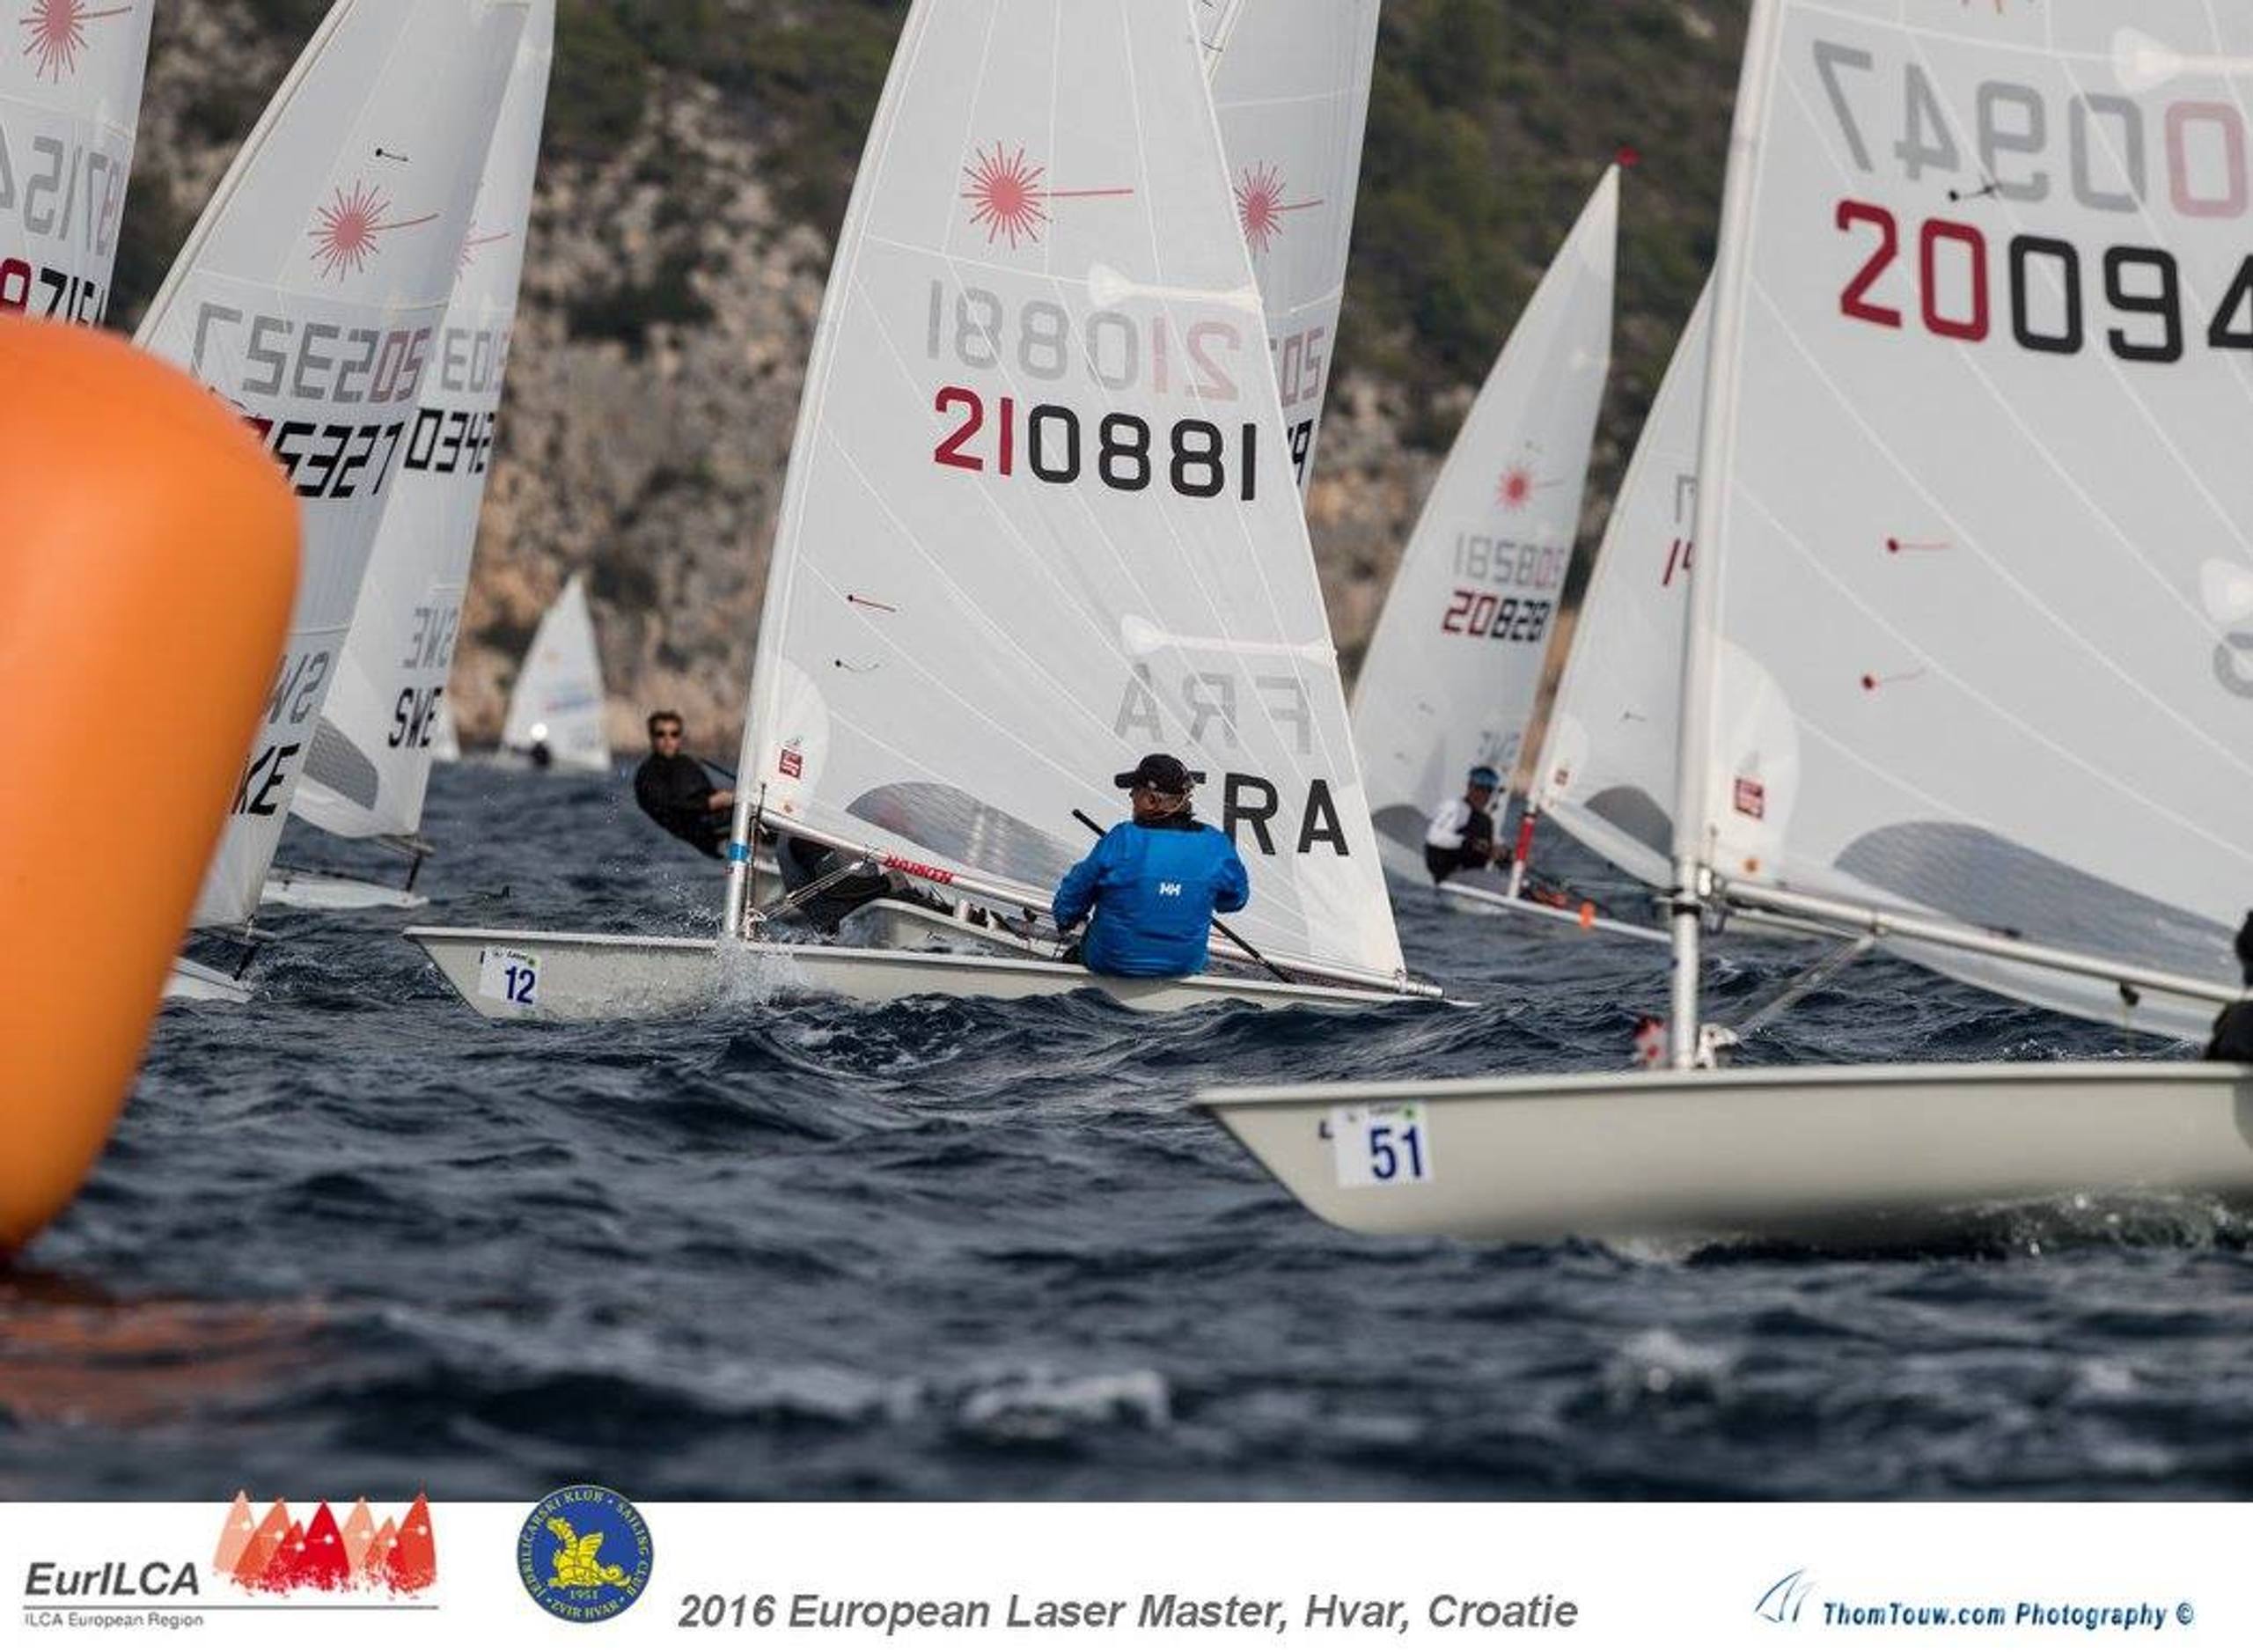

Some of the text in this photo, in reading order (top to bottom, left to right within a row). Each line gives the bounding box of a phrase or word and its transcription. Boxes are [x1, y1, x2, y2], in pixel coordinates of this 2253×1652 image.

[933, 385, 1257, 501] 210881
[389, 687, 443, 748] SWE
[505, 966, 535, 1004] 12
[1370, 1126, 1421, 1179] 51
